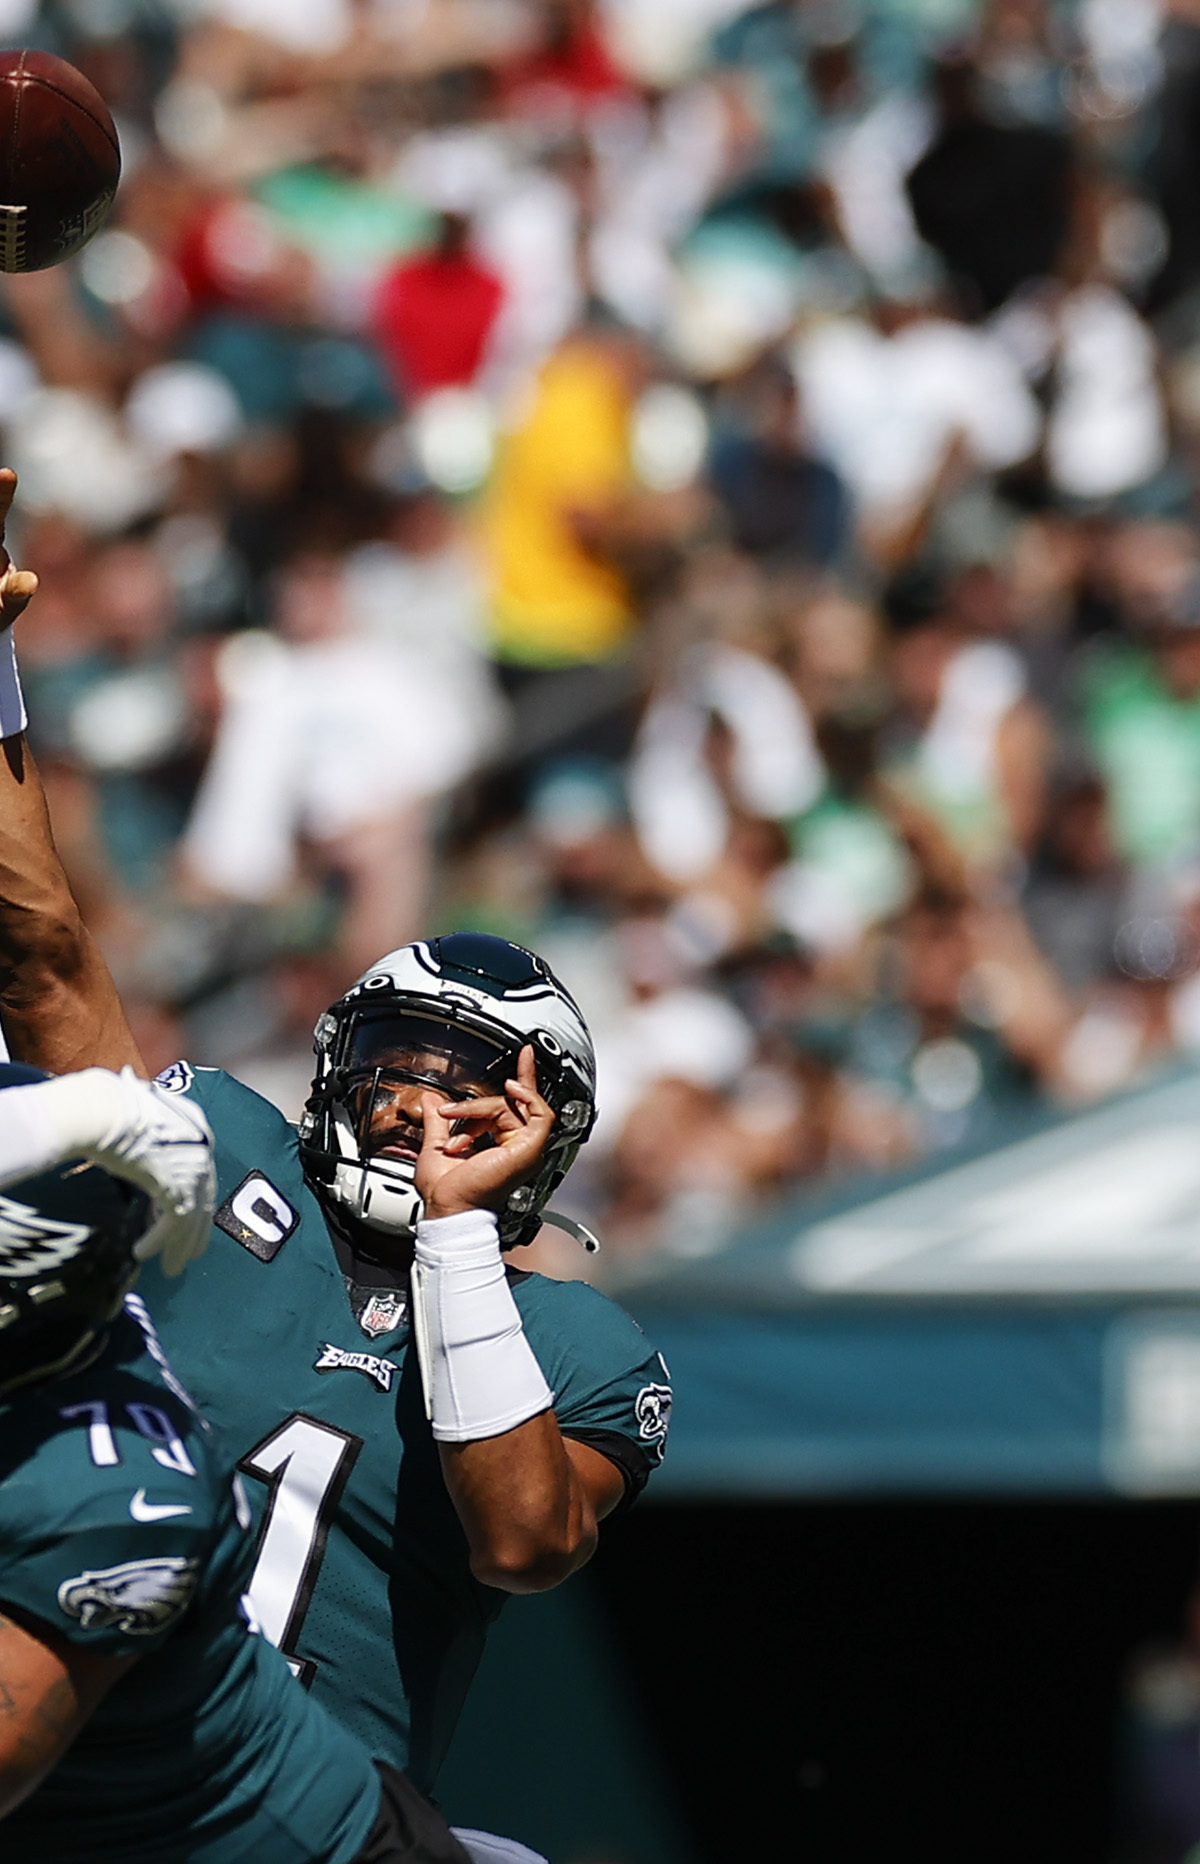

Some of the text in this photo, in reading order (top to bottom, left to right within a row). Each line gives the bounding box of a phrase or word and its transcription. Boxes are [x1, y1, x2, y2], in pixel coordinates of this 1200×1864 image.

[231, 1178, 294, 1243] C
[314, 1343, 399, 1391] EAGLES
[59, 1400, 197, 1477] 79
[240, 1412, 362, 1690] 1
